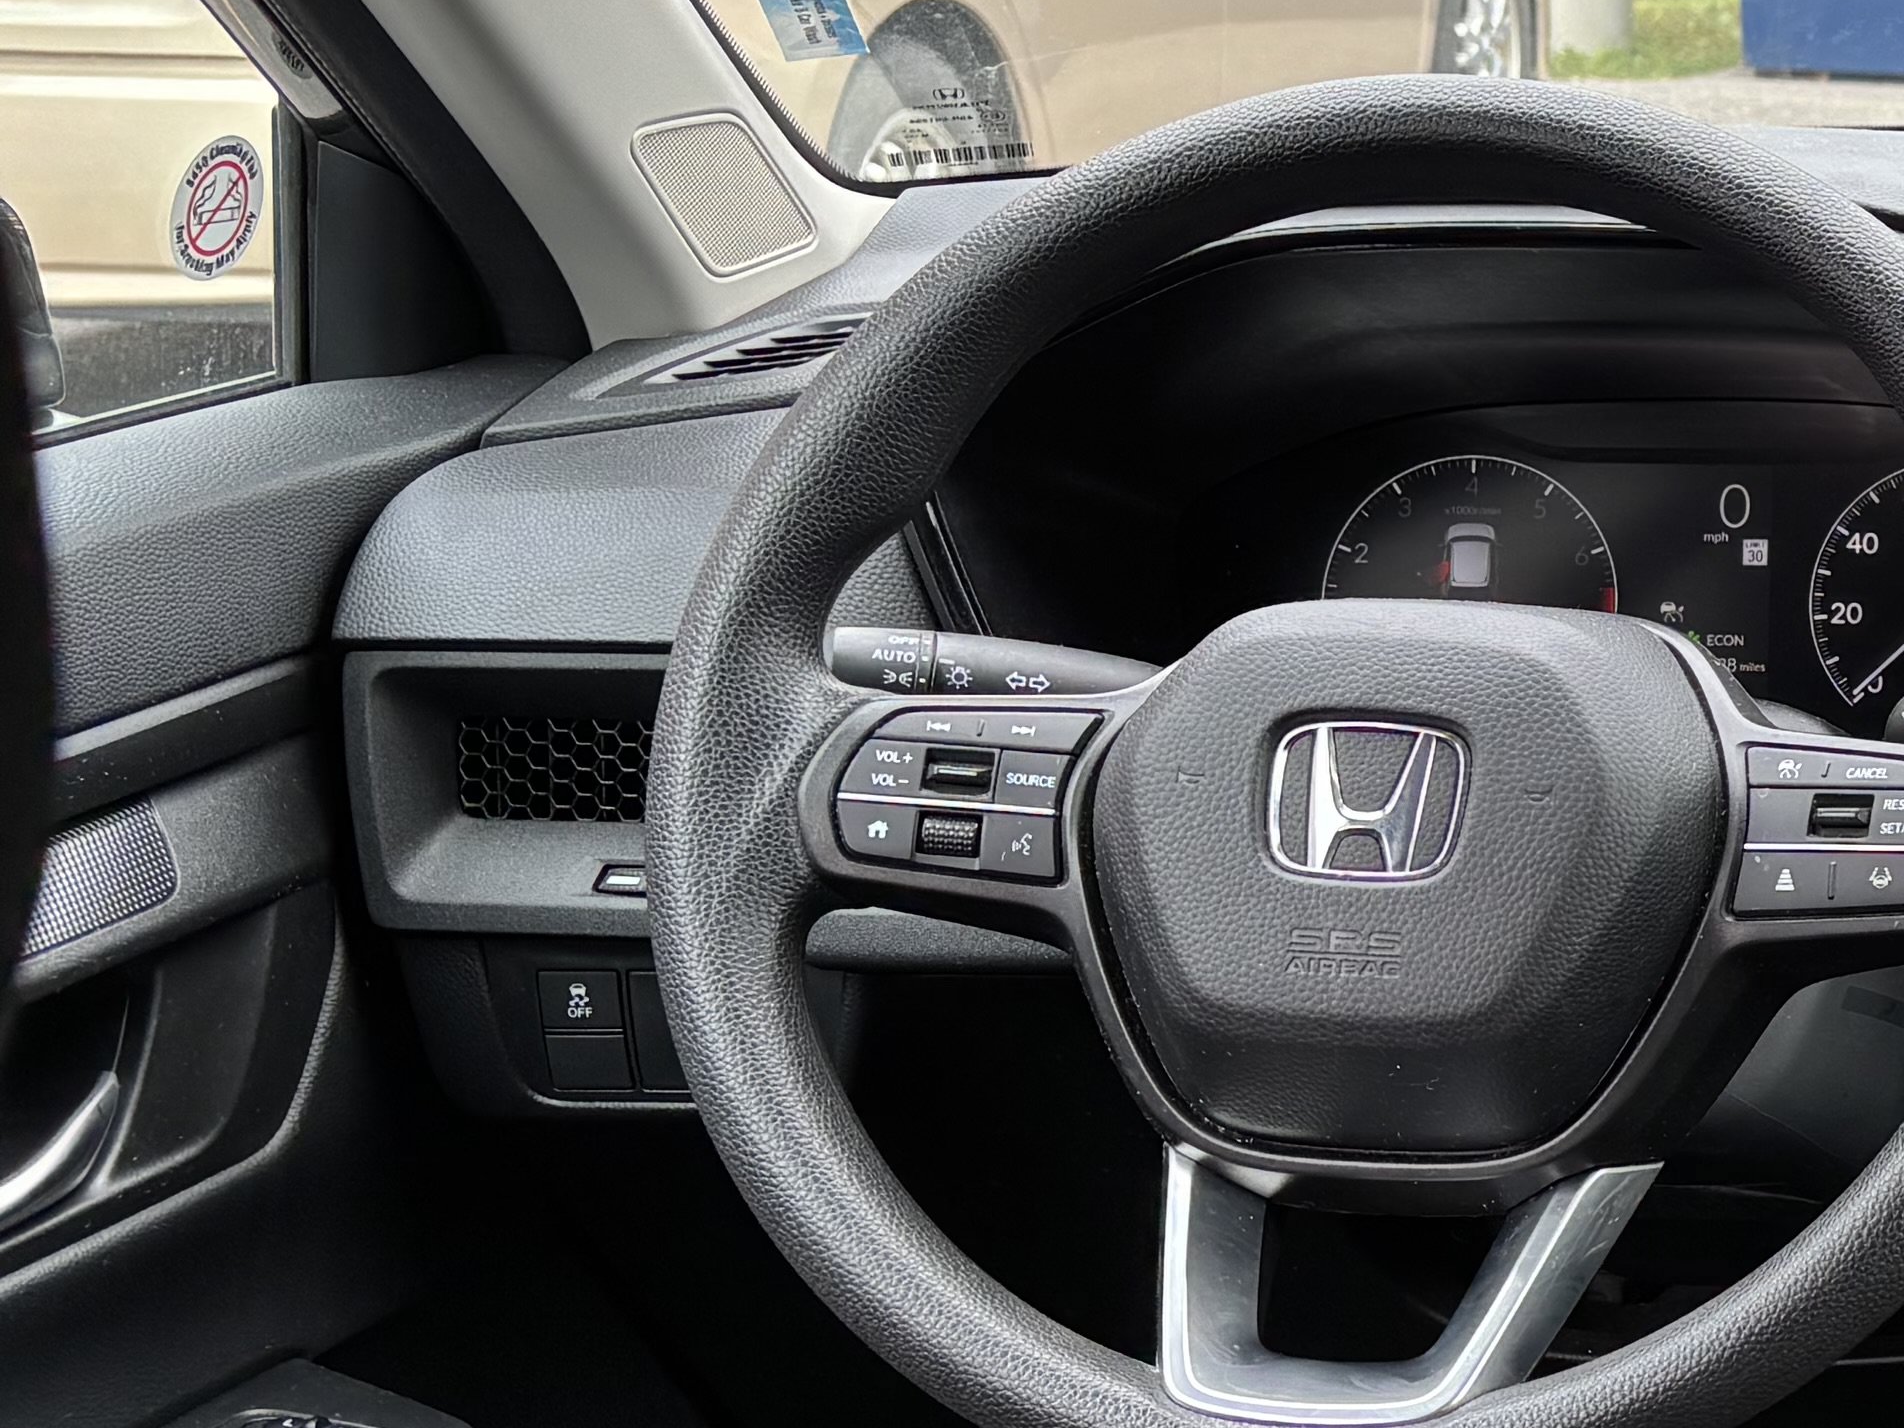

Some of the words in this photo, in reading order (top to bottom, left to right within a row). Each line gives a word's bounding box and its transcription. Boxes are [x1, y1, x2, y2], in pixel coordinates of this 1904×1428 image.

[1464, 476, 1479, 496] 4
[1398, 497, 1412, 518] 3
[1533, 499, 1547, 519] 5
[1719, 483, 1751, 529] 0
[1703, 531, 1729, 544] mph
[1845, 532, 1879, 556] 40
[1353, 542, 1369, 564] 2
[1575, 546, 1589, 566] 6
[1747, 550, 1764, 563] 30
[1830, 601, 1864, 625] 20
[1706, 634, 1745, 647] ECON
[871, 648, 916, 663] AUTO
[1739, 661, 1766, 672] miles
[1005, 772, 1056, 789] SOURCE
[1845, 766, 1888, 780] CANCEL
[1286, 926, 1401, 954] SRS
[1283, 956, 1401, 977] AIRBAG
[567, 1006, 594, 1019] OFF
